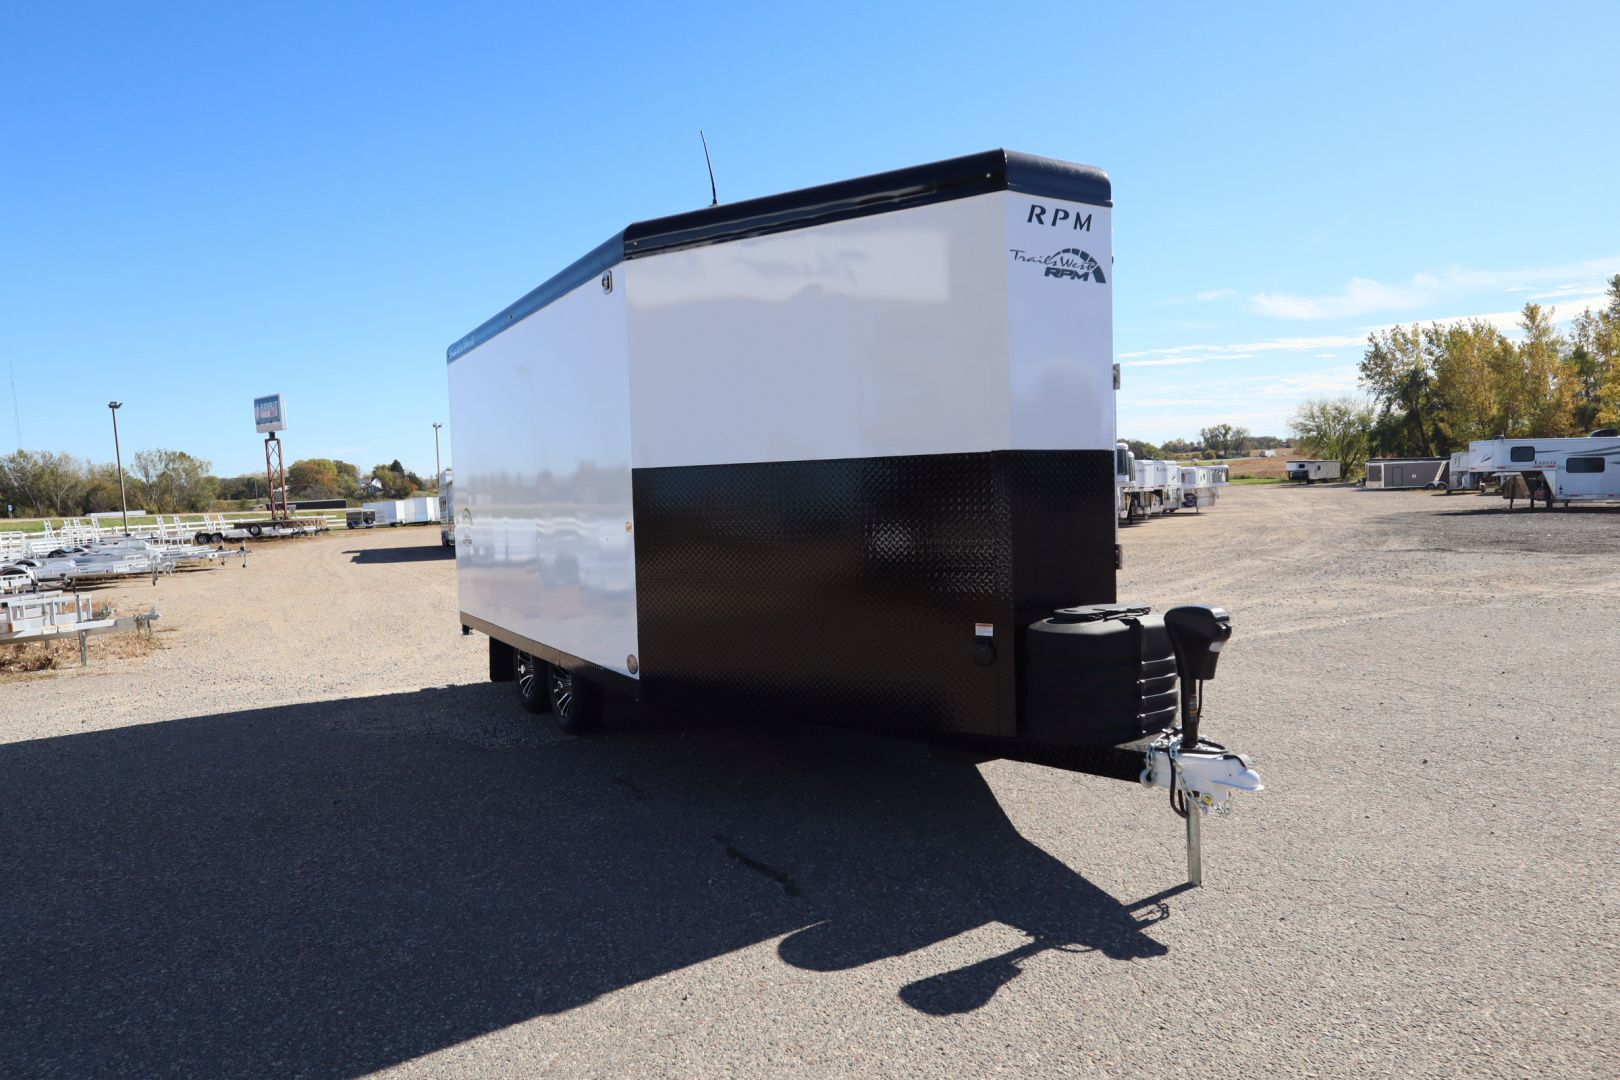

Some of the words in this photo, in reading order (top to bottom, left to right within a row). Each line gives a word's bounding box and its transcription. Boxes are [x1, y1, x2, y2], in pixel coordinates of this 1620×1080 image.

[1027, 204, 1093, 232] RPM
[1009, 249, 1058, 267] Trails
[1060, 256, 1094, 271] West
[1044, 266, 1090, 282] RPM
